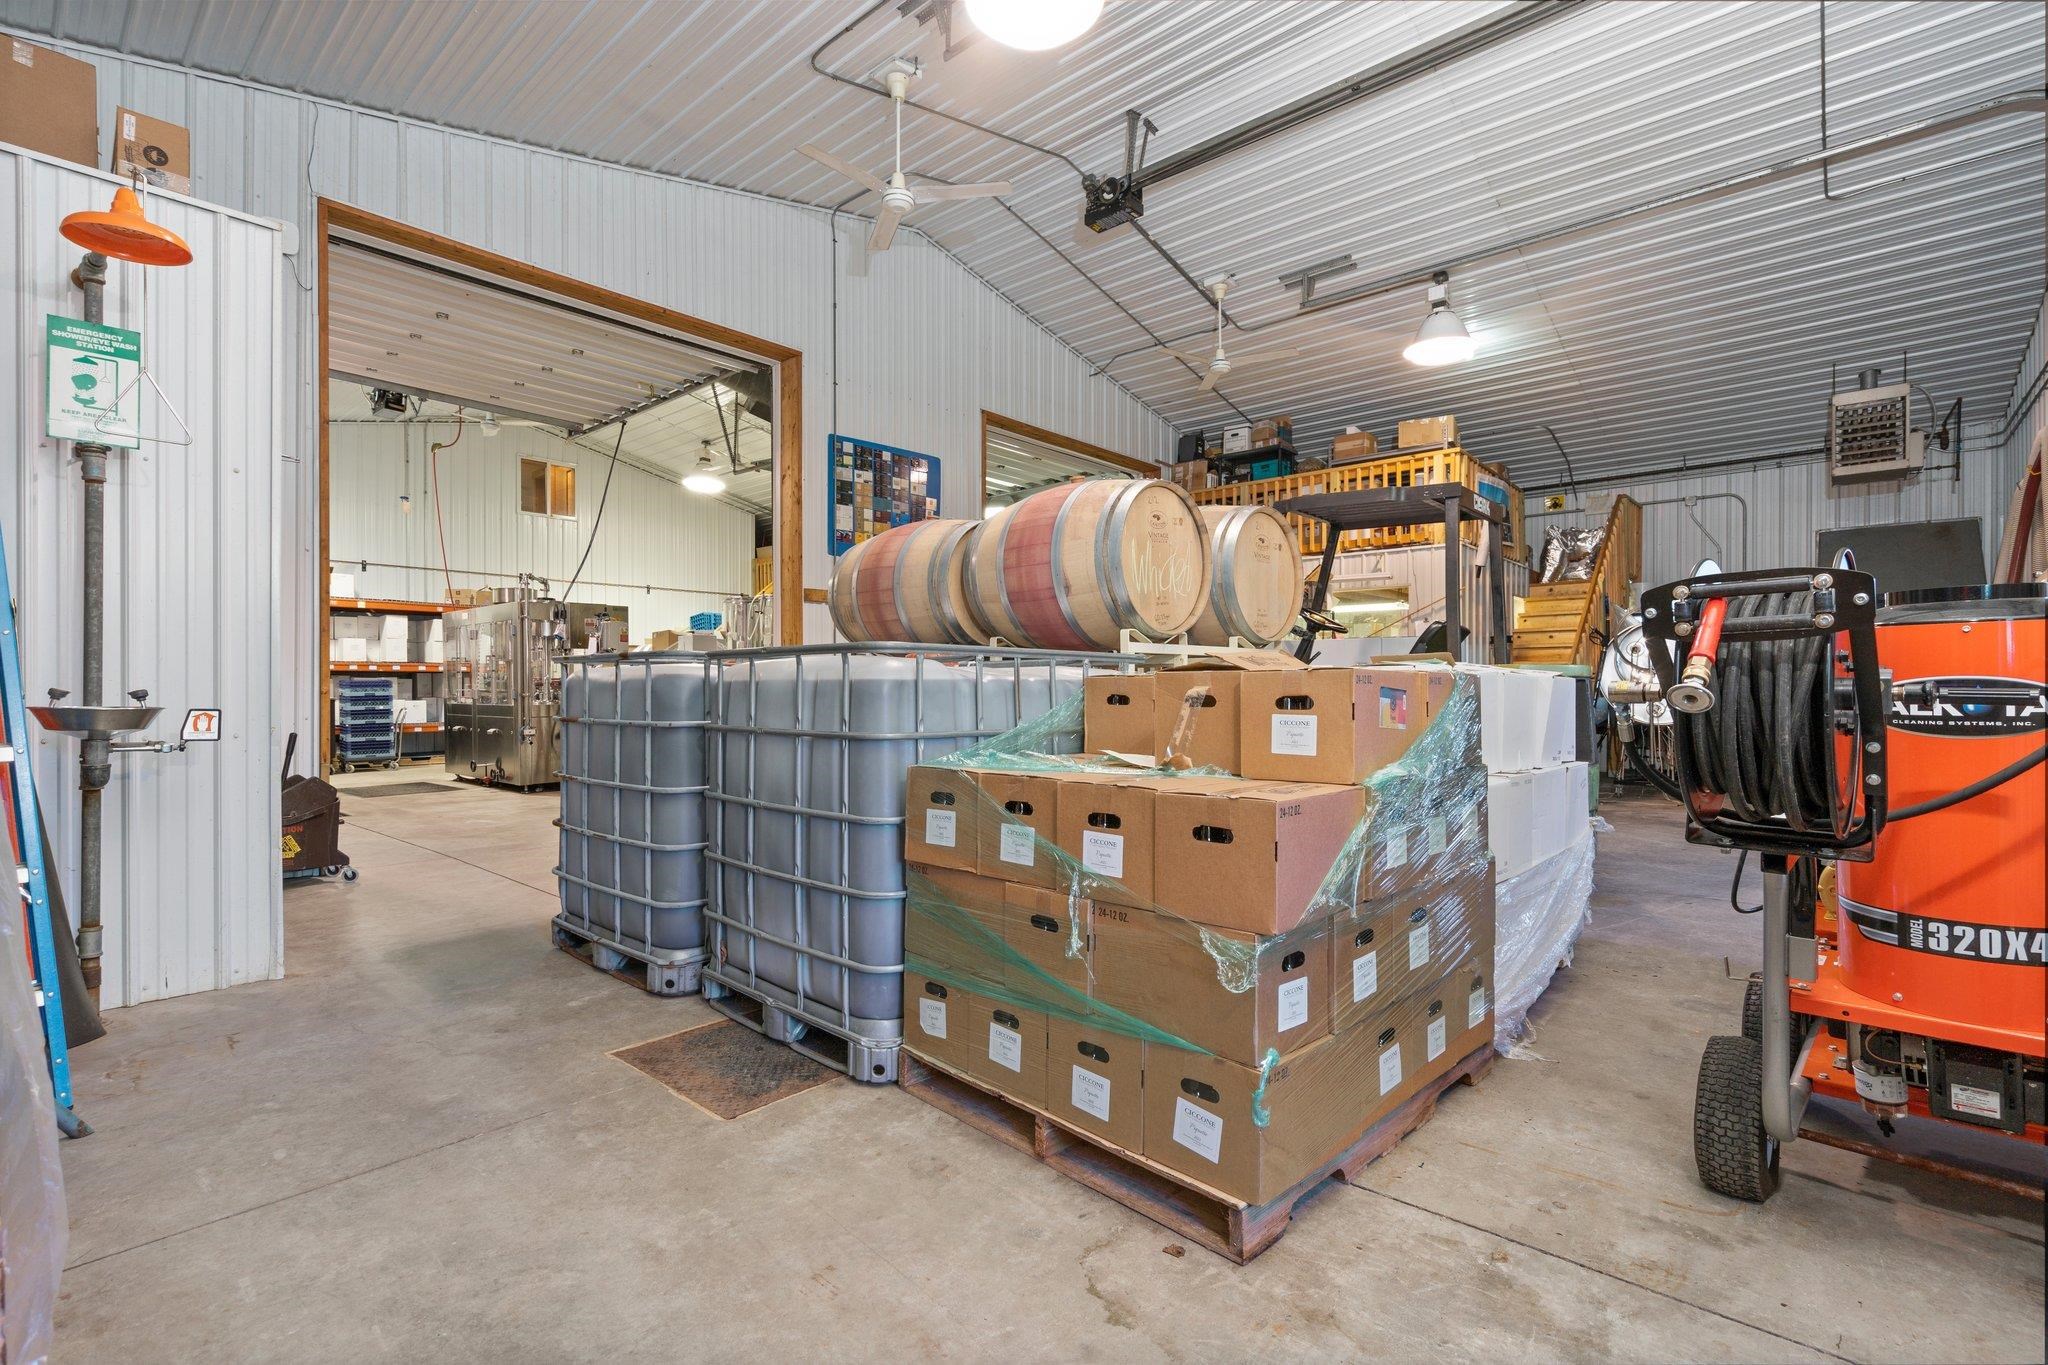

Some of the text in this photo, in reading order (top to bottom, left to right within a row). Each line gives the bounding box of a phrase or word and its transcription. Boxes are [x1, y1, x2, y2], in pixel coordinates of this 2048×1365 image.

[51, 329, 137, 352] SHOWER/EYE WASH
[66, 326, 124, 342] EMERGENCY
[75, 340, 115, 353] STATION
[1279, 719, 1311, 727] CICCONE
[1280, 806, 1293, 819] 24-12
[1089, 837, 1118, 848] CICCONE
[1098, 906, 1117, 921] 24-12
[1910, 919, 2048, 963] MODEL 320X4
[1283, 984, 1304, 997] CICCONE
[1078, 1073, 1104, 1090] CICCONE
[1184, 1107, 1216, 1129] CICCONE
